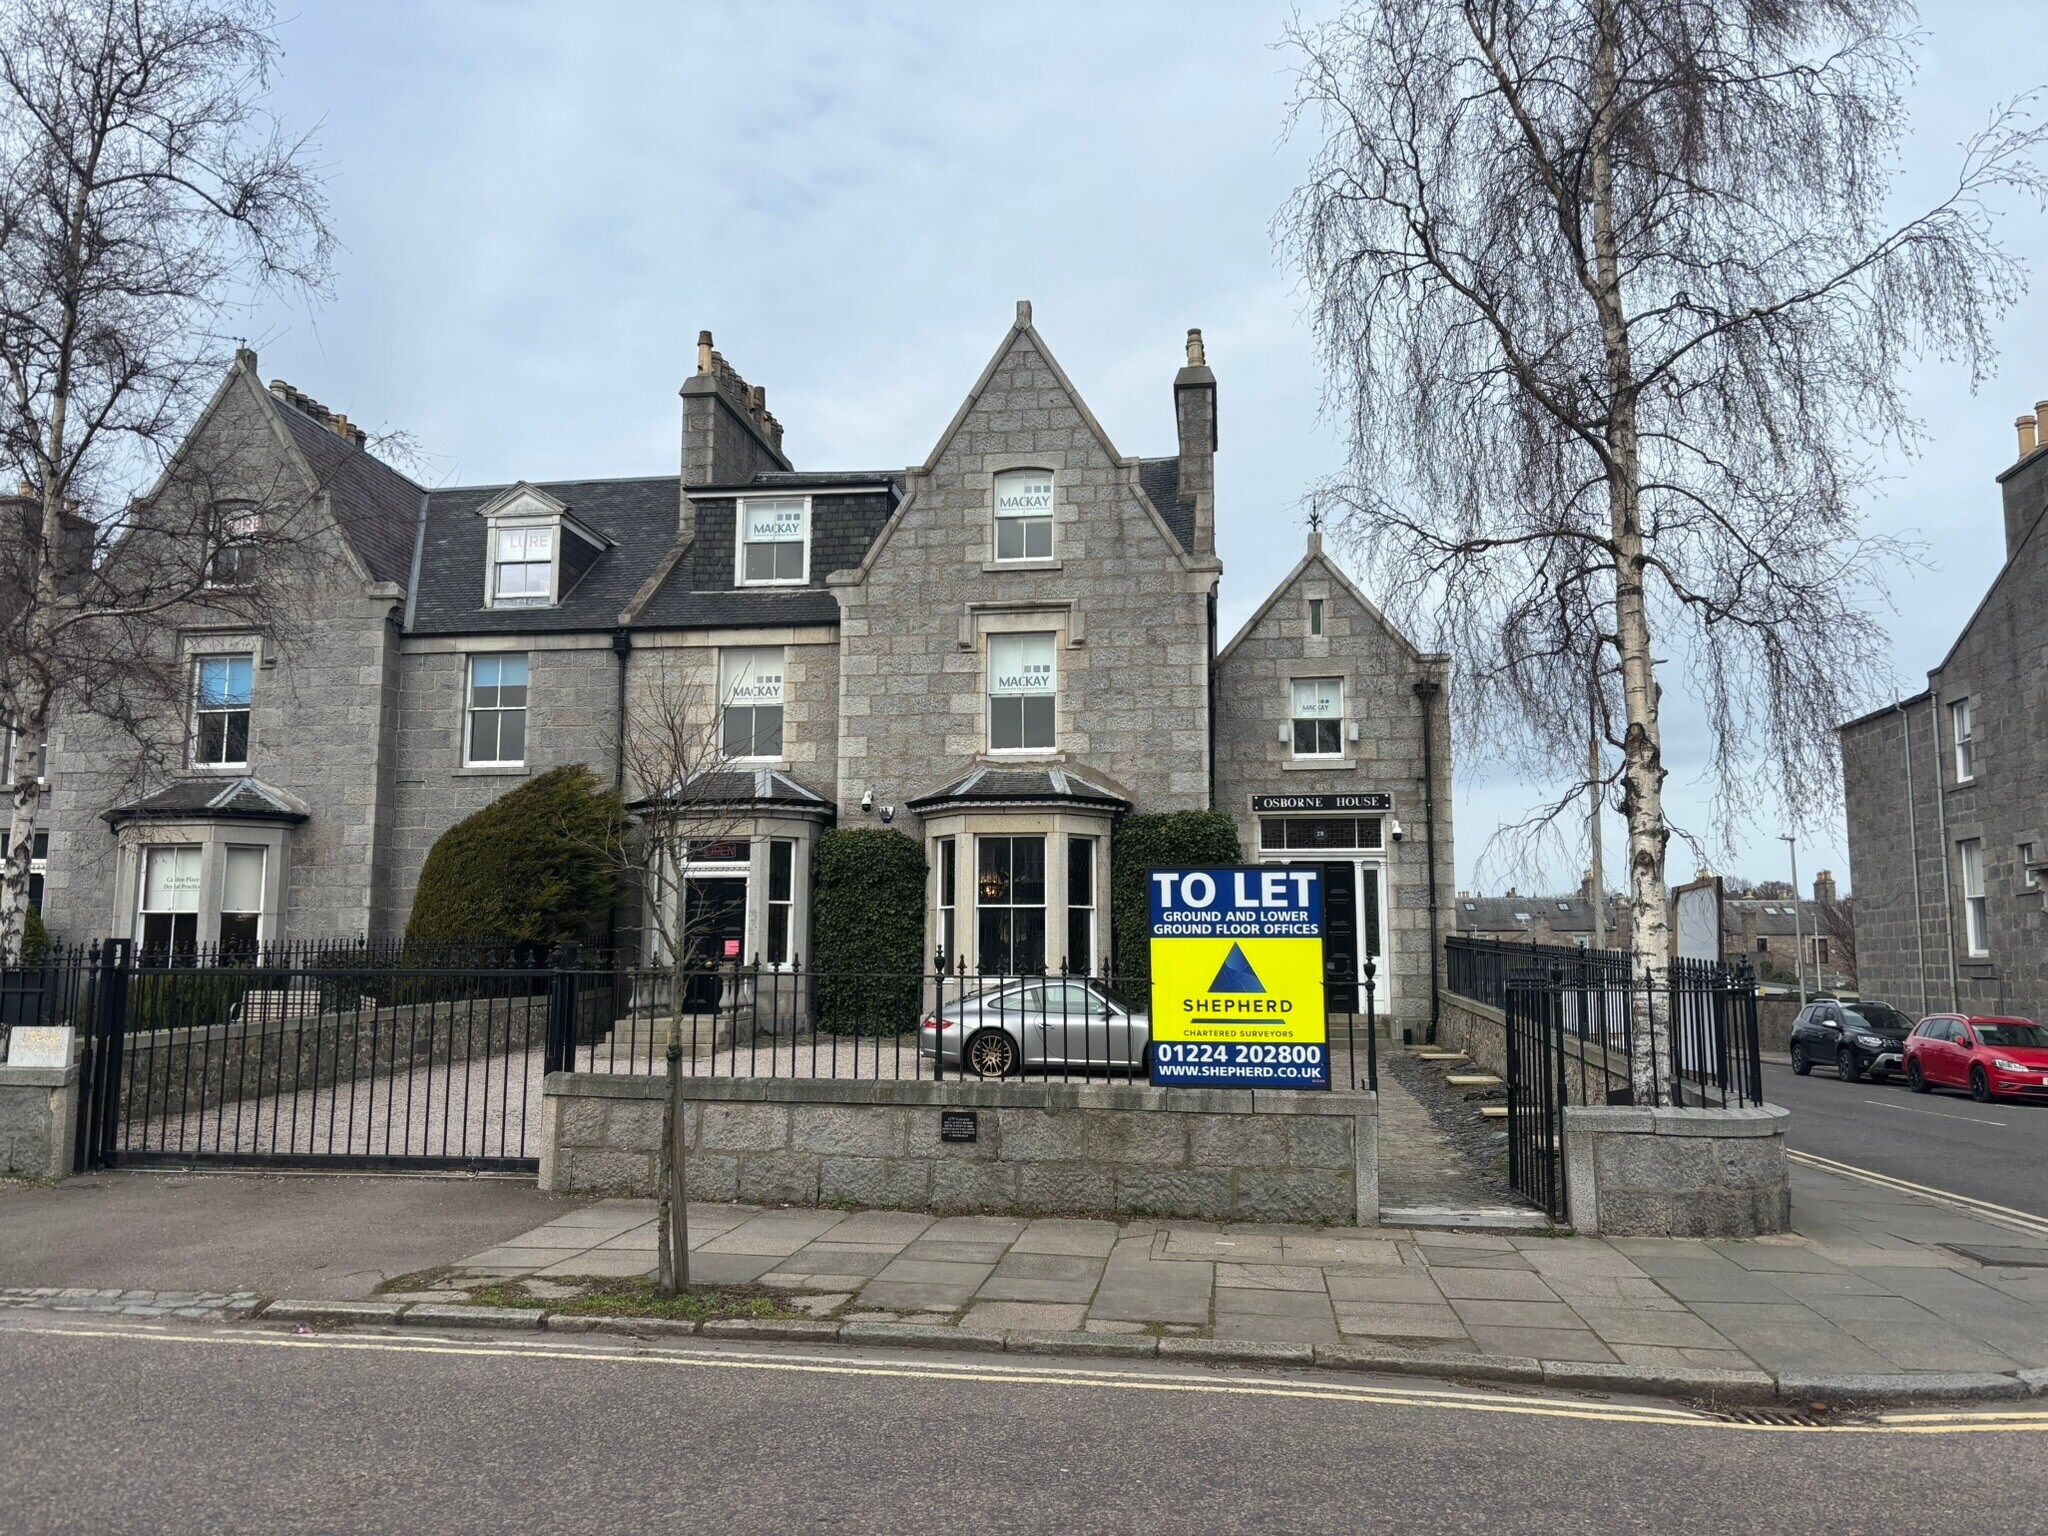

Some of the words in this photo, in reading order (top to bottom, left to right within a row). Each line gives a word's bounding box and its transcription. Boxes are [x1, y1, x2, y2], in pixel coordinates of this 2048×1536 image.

[1000, 496, 1050, 508] MACKAY
[754, 523, 800, 534] MACKAY
[999, 676, 1050, 687] MACKAY
[733, 686, 781, 697] MACKAY
[1263, 797, 1323, 808] OSBORNE
[1336, 796, 1379, 807] HOUSE
[1152, 872, 1216, 908] TO
[1234, 872, 1317, 908] LET
[1163, 911, 1221, 922] GROUND
[1225, 911, 1256, 922] AND
[1260, 911, 1308, 922] LOWER
[1153, 924, 1212, 935] GROUND
[1216, 924, 1260, 935] FLOOR
[1264, 924, 1319, 935] OFFICES
[1183, 999, 1293, 1013] SHEPHERD
[1183, 1029, 1237, 1037] CHARTERED
[1240, 1030, 1294, 1038] SURVEYORS
[1158, 1044, 1228, 1062] 01224
[1236, 1045, 1321, 1064] 202800
[1159, 1066, 1322, 1078] WWW.SHEPHERD.CO.UK
